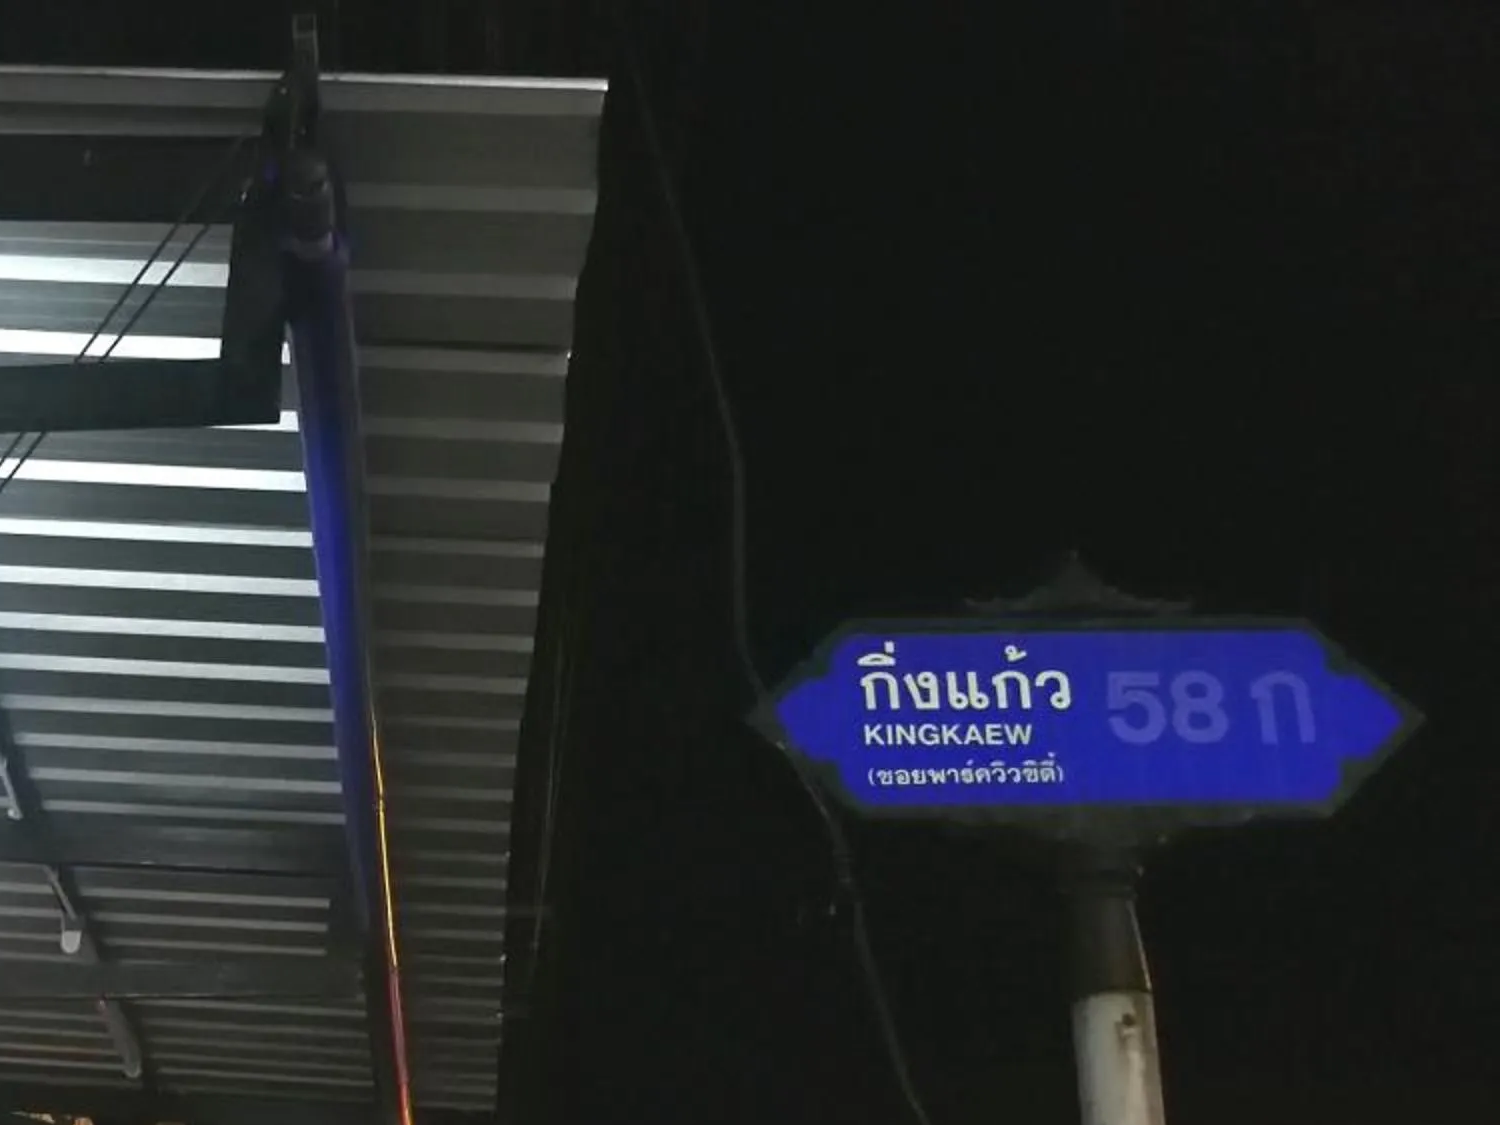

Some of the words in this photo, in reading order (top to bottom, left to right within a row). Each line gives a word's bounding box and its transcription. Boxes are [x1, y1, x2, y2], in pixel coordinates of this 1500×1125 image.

[856, 641, 1072, 711] กิ่งแก้ว
[1107, 670, 1228, 746] 58
[1249, 670, 1317, 746] ก
[863, 723, 1033, 746] KINGKAEW
